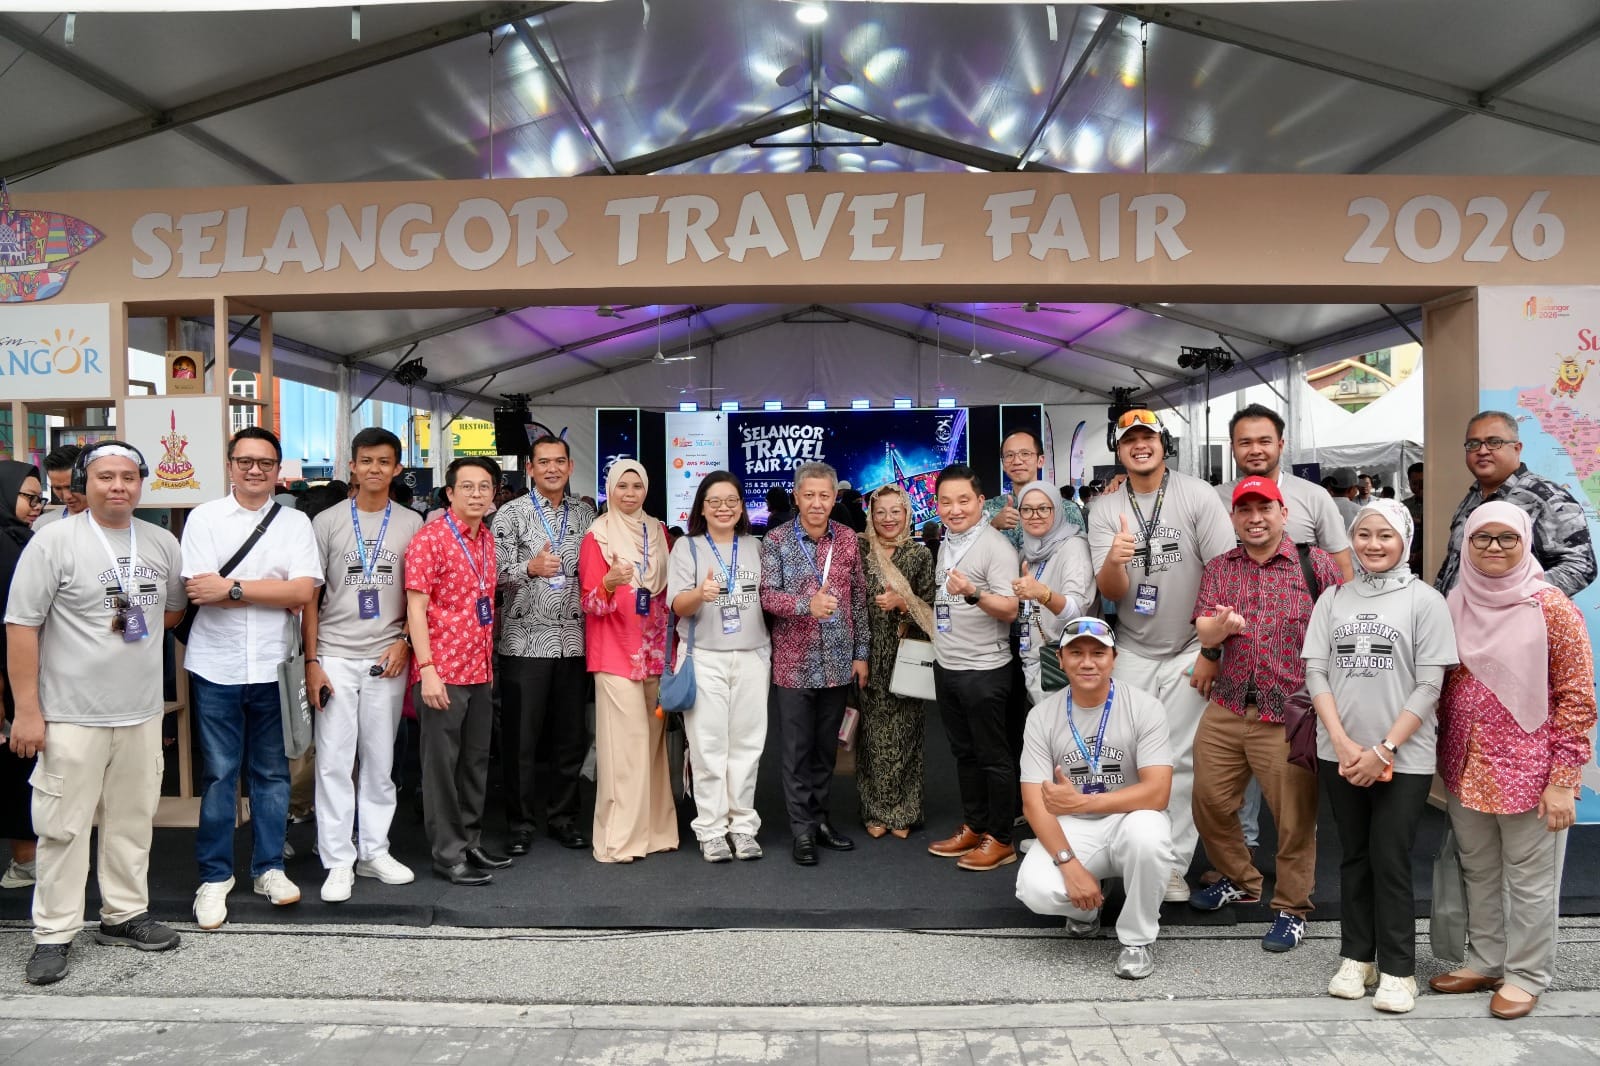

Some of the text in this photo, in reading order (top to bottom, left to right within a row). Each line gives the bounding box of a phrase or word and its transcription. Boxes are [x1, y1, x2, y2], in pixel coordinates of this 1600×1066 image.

[131, 189, 1566, 280] SELANGOR TRAVEL FAIR 2026
[0, 348, 103, 376] NGOR
[743, 424, 825, 441] SELANGOR
[741, 438, 826, 461] TRAVEL
[745, 457, 825, 475] FAIR 20
[344, 548, 399, 564] SURRSING
[1131, 552, 1182, 569] SEANGOR
[98, 566, 159, 585] SURPRSING
[1333, 621, 1400, 643] SURPRISING
[1336, 655, 1393, 670] SELANGOR
[1063, 745, 1124, 765] SURRSING
